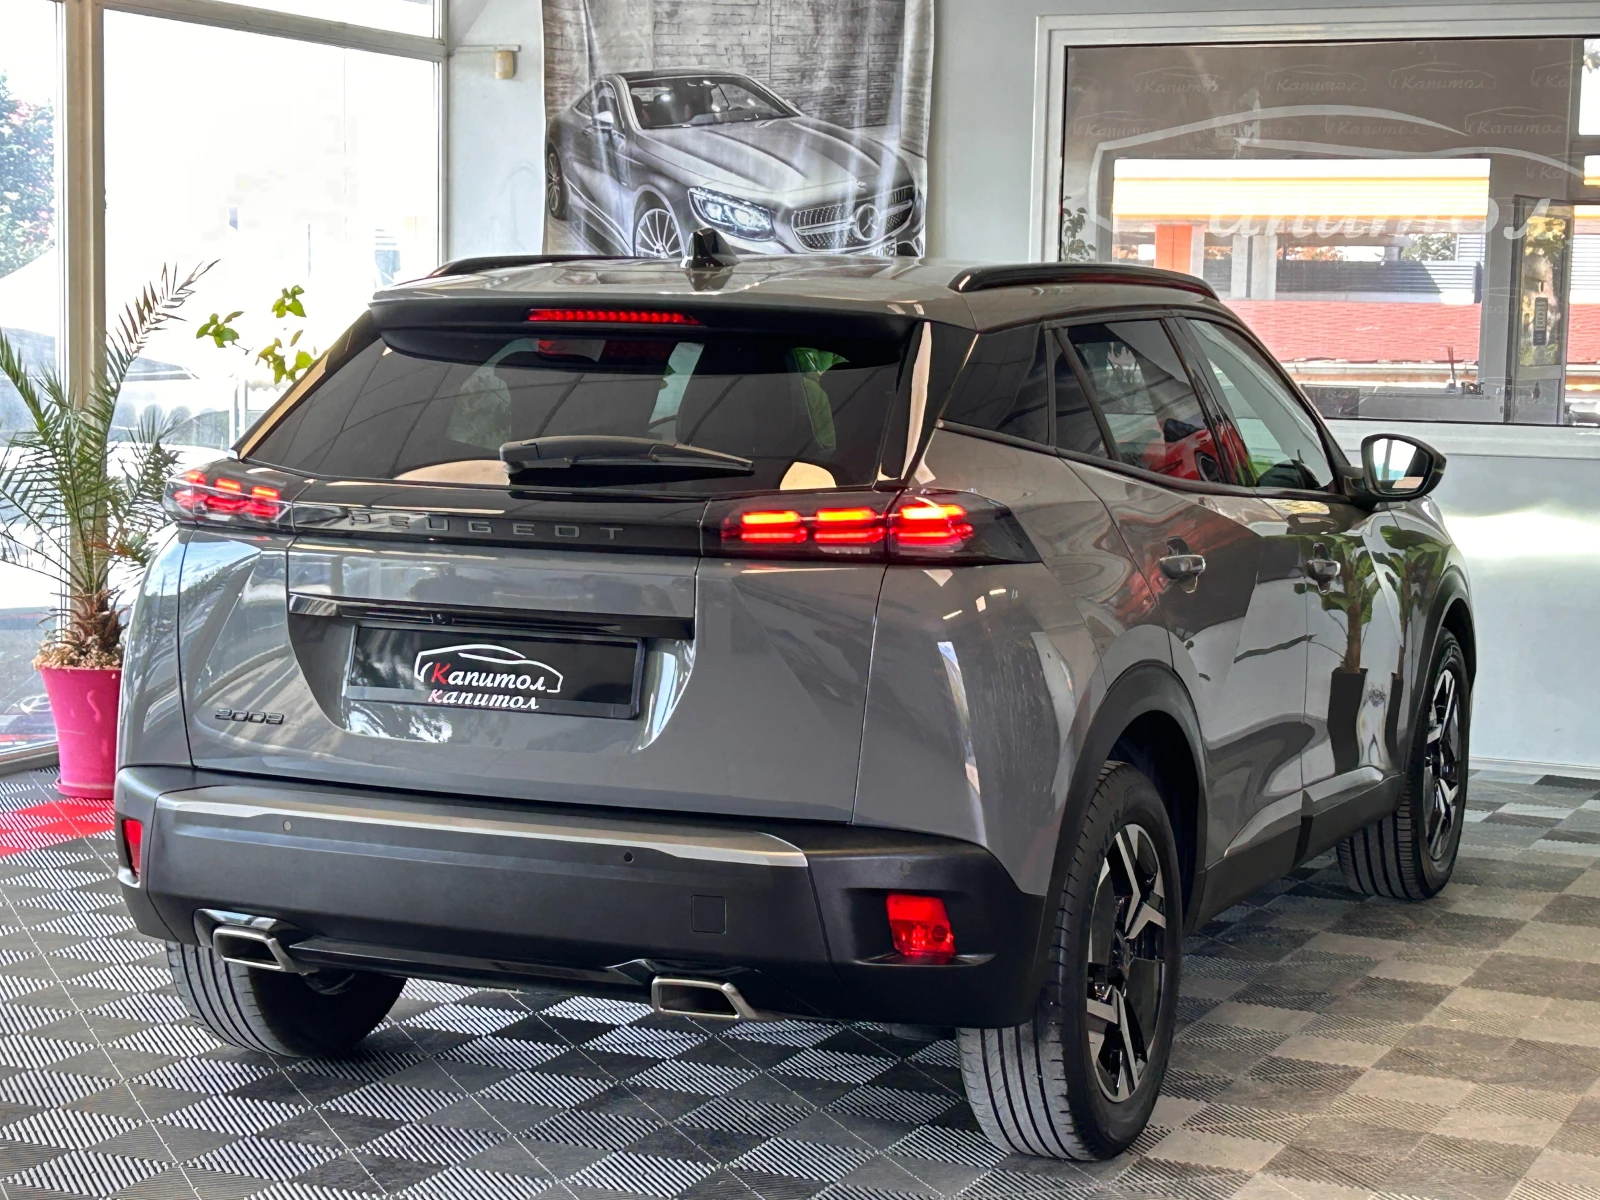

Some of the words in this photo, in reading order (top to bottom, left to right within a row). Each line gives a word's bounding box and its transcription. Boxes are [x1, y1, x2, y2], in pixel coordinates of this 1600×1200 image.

[348, 512, 624, 541] PEUGEOT
[430, 662, 546, 691] Капитол
[214, 707, 285, 725] 2008
